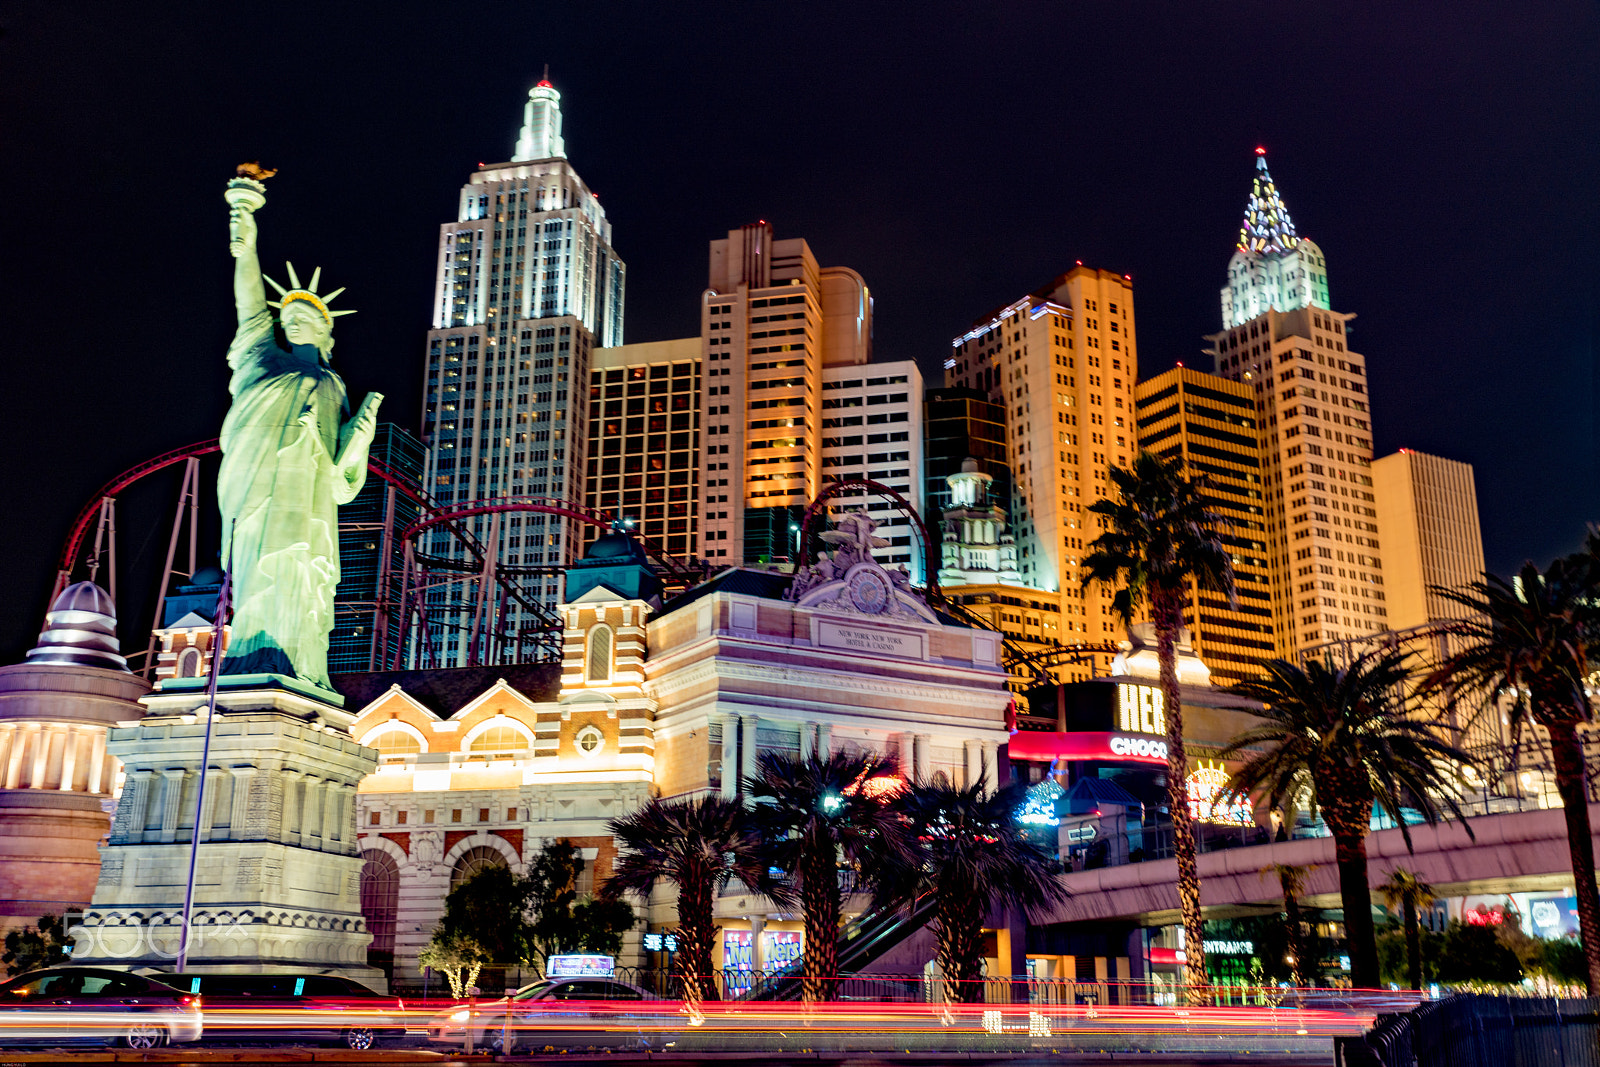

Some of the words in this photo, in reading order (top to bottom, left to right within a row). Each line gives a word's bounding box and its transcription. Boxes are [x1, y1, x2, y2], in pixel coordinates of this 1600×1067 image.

[838, 630, 852, 638] NEW
[854, 632, 871, 640] YORK
[872, 634, 885, 642] NEW
[886, 636, 903, 645] YORK
[846, 639, 865, 647] HOTEL
[872, 643, 895, 651] CASINO
